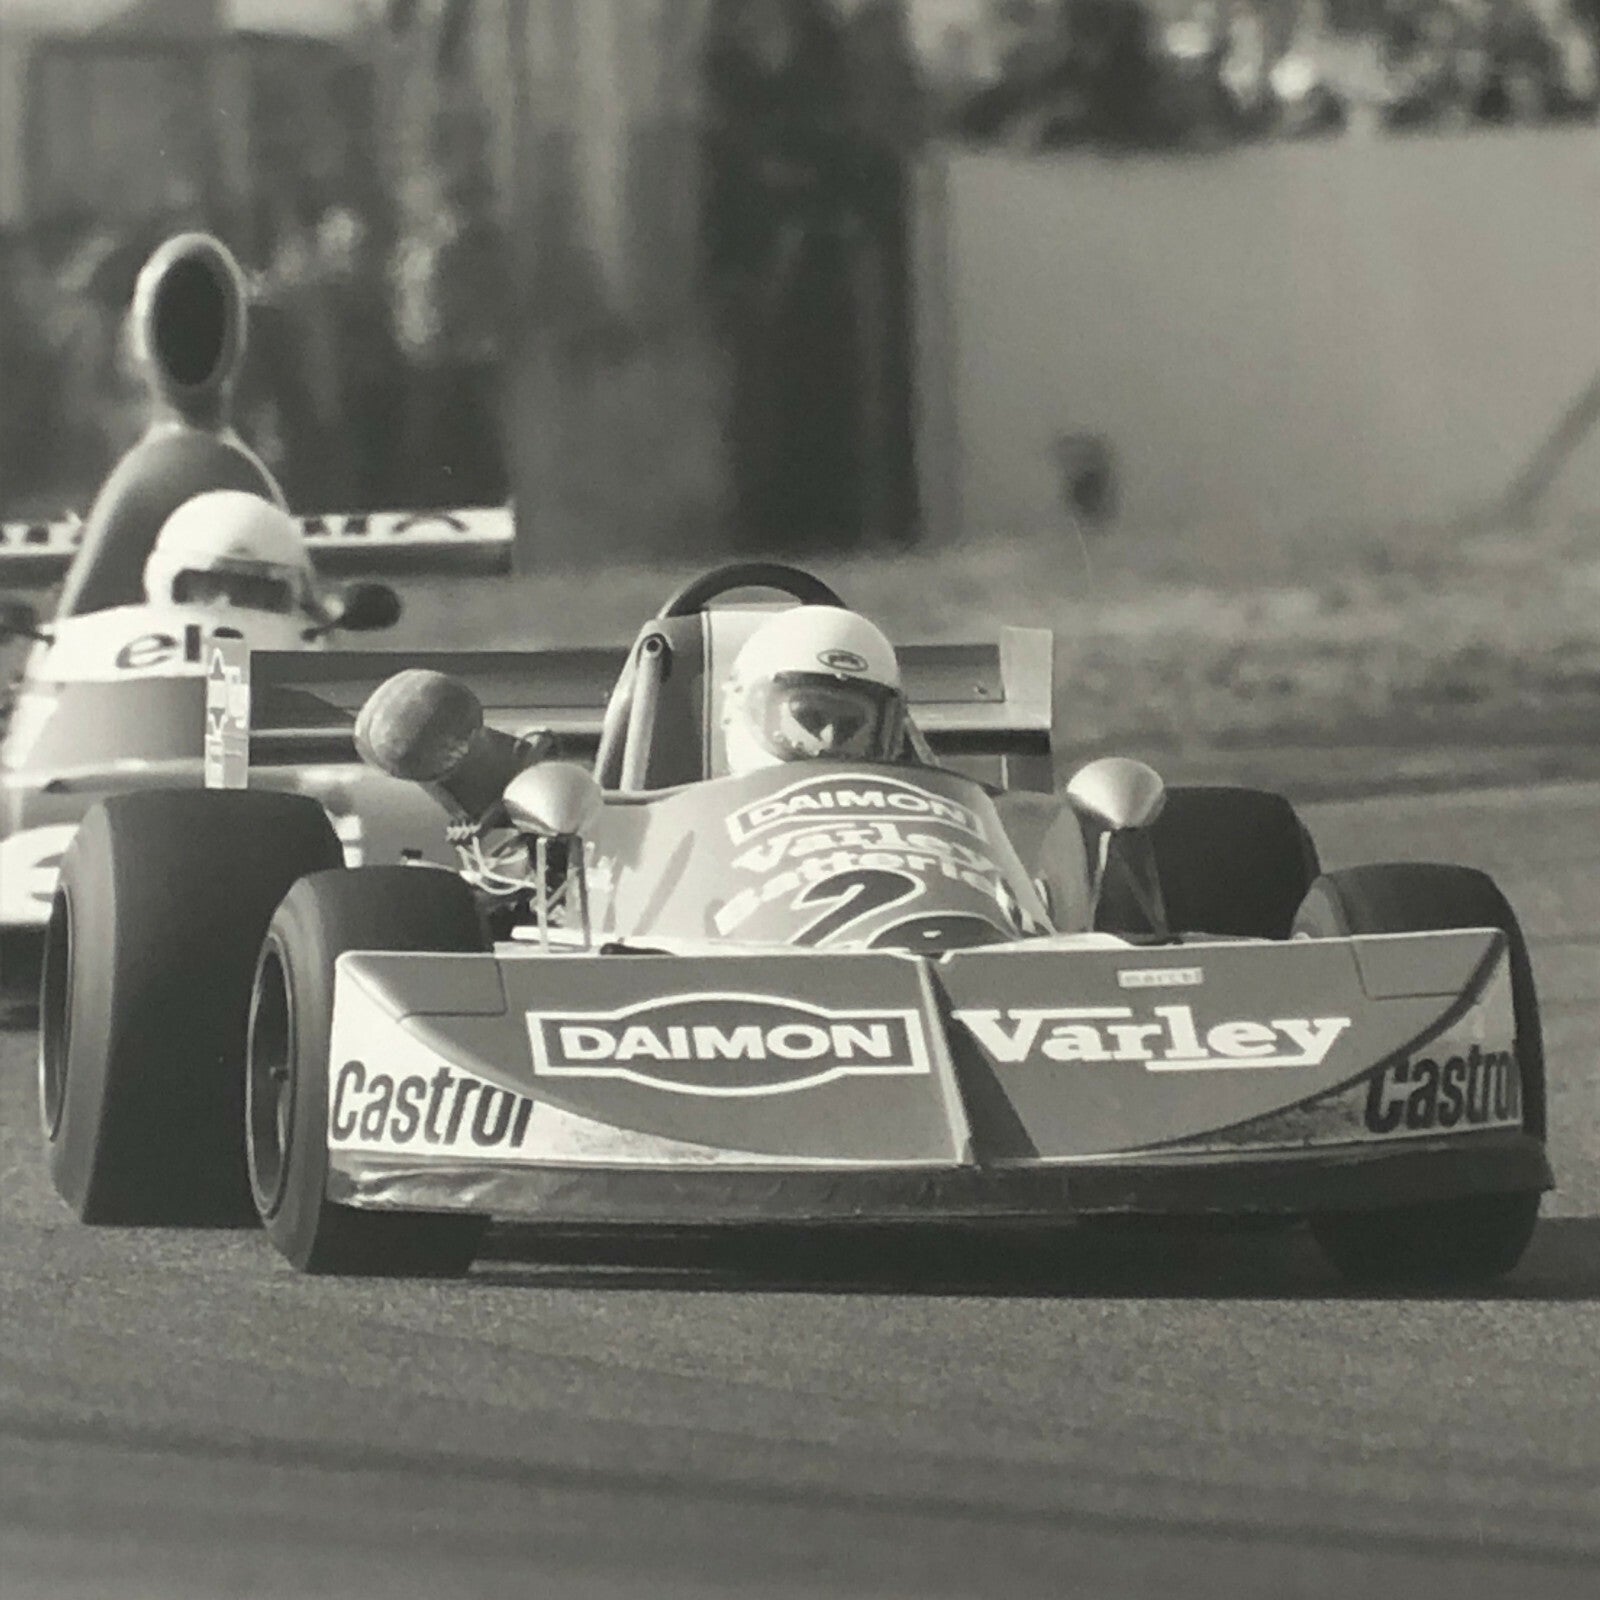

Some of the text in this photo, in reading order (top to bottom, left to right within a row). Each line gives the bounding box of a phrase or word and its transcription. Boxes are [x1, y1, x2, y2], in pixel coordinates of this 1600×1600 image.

[115, 624, 244, 669] el
[751, 790, 967, 829] DAIMON
[559, 1025, 892, 1061] DAIMON
[952, 1005, 1352, 1071] Varley
[332, 1059, 535, 1149] Castrol
